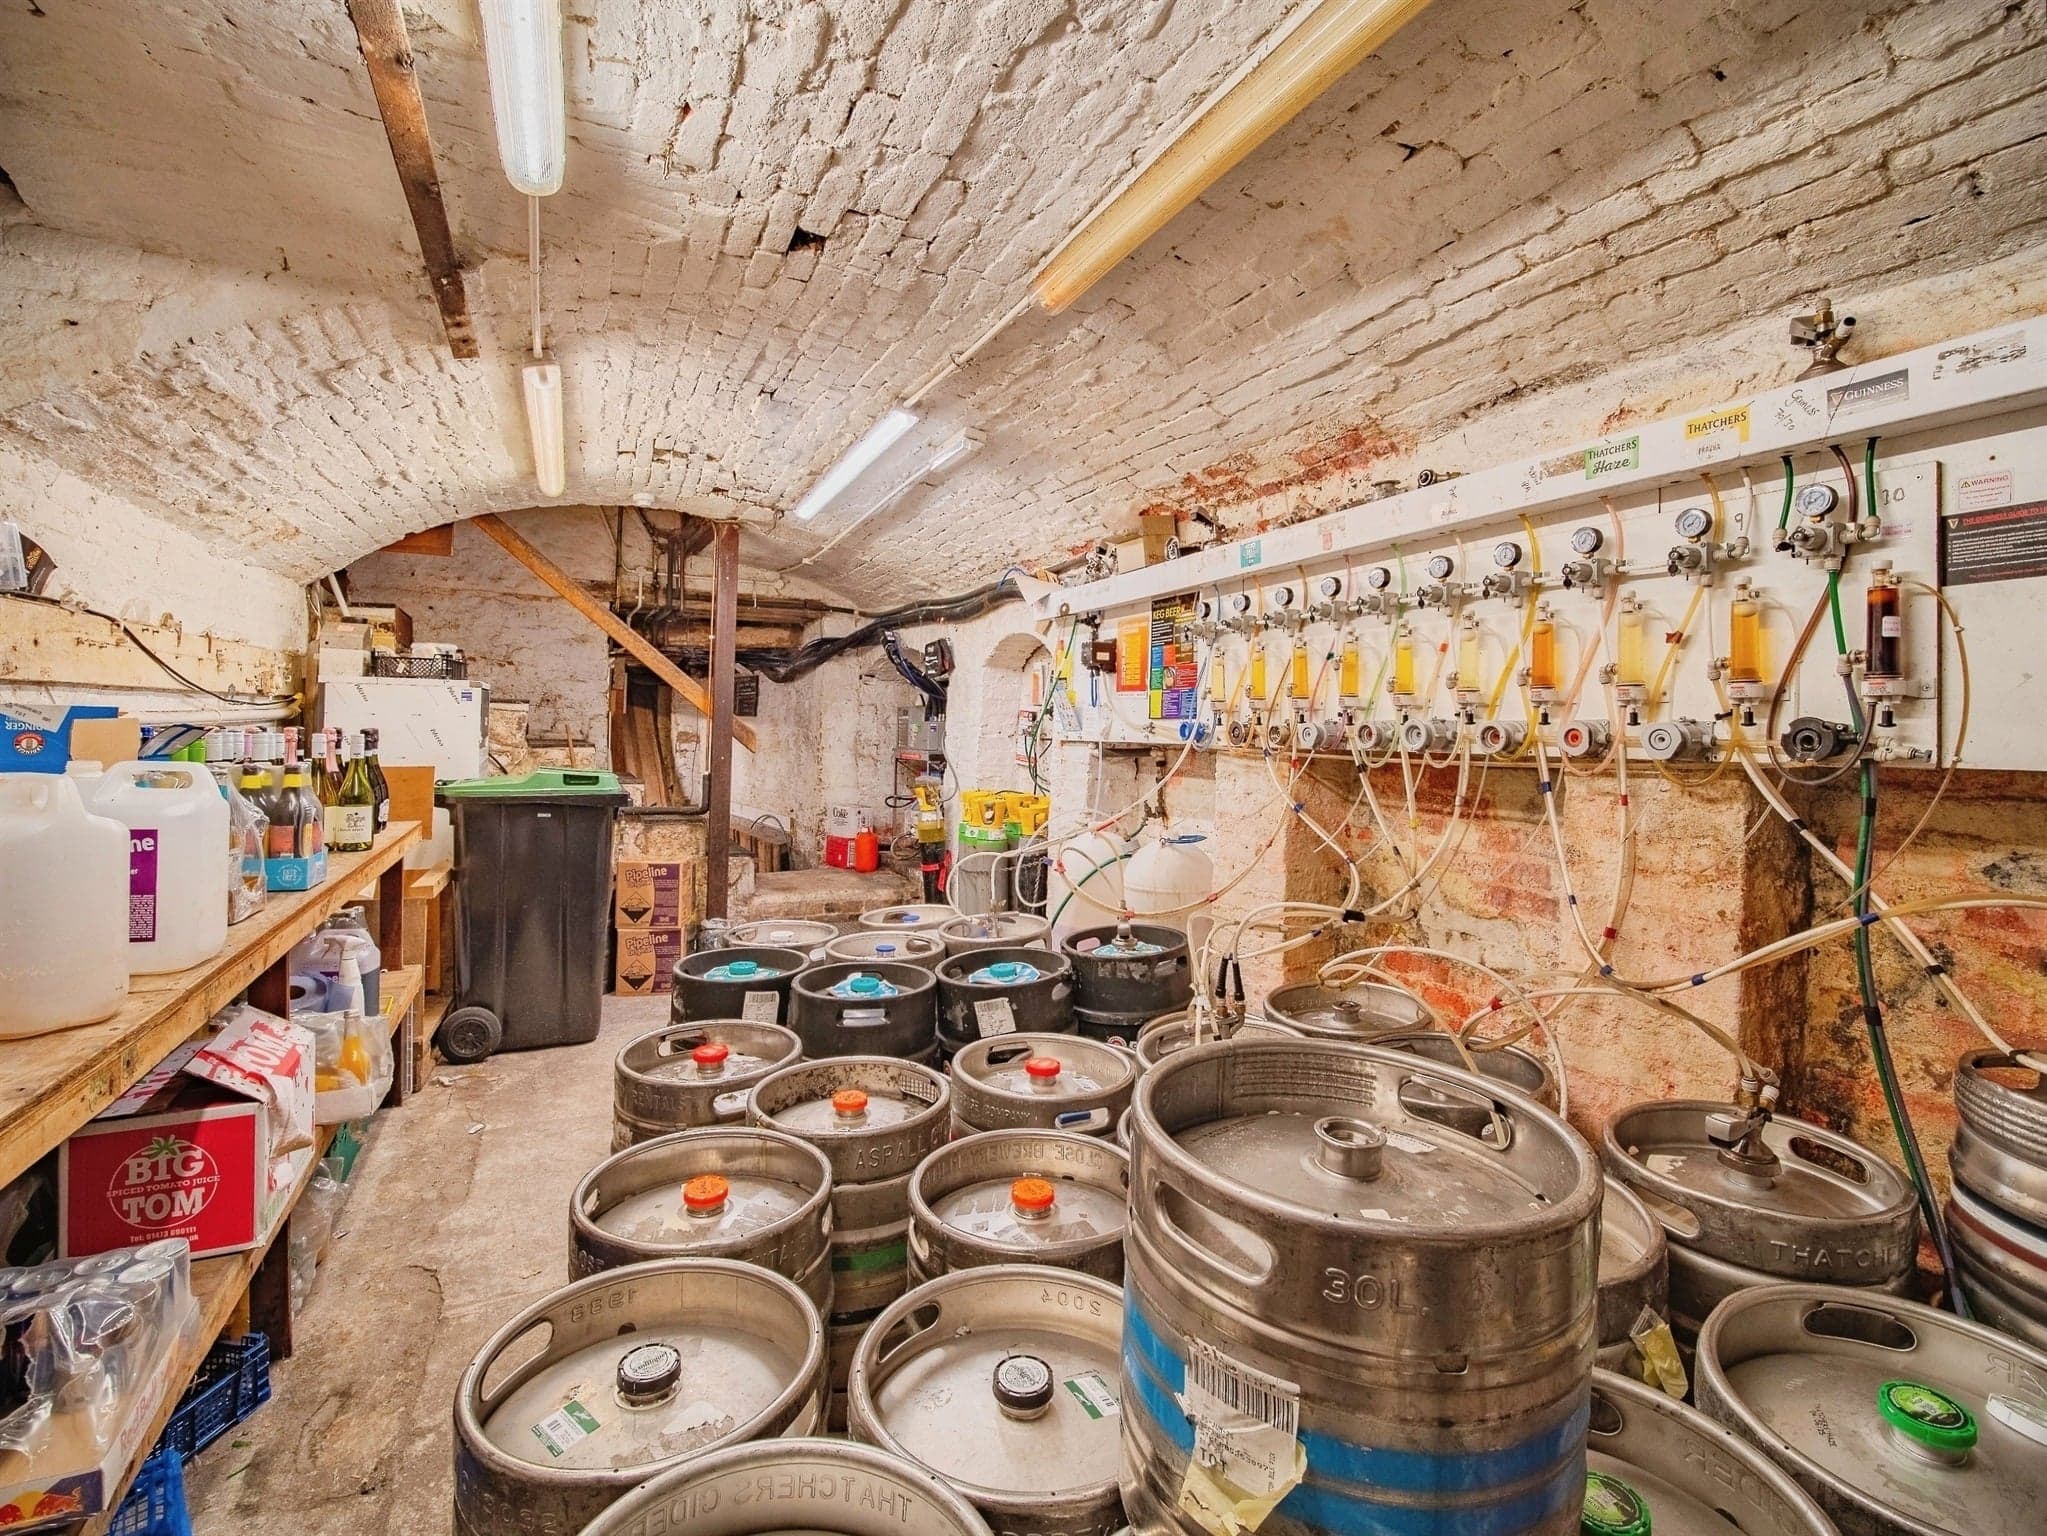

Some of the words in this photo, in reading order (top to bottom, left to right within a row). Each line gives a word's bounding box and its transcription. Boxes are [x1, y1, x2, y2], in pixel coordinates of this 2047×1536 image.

[1844, 378, 1904, 401] GUINNESS
[1687, 411, 1748, 434] THATCHERS
[1588, 439, 1637, 460] THATCHERS
[1592, 457, 1631, 475] Haze
[1971, 474, 2009, 487] WARNING
[1881, 487, 1905, 506] 10
[1734, 512, 1744, 531] 9
[1153, 608, 1165, 621] KEG
[1165, 605, 1182, 618] BEER
[625, 866, 668, 881] Pipeline
[625, 934, 669, 951] Pipeline
[125, 1148, 205, 1186] BIG
[106, 1187, 145, 1198] SPICED
[146, 1179, 190, 1192] TOMATO
[193, 1175, 221, 1187] JUICE
[123, 1187, 206, 1224] TOM
[1322, 1266, 1416, 1313] 30L
